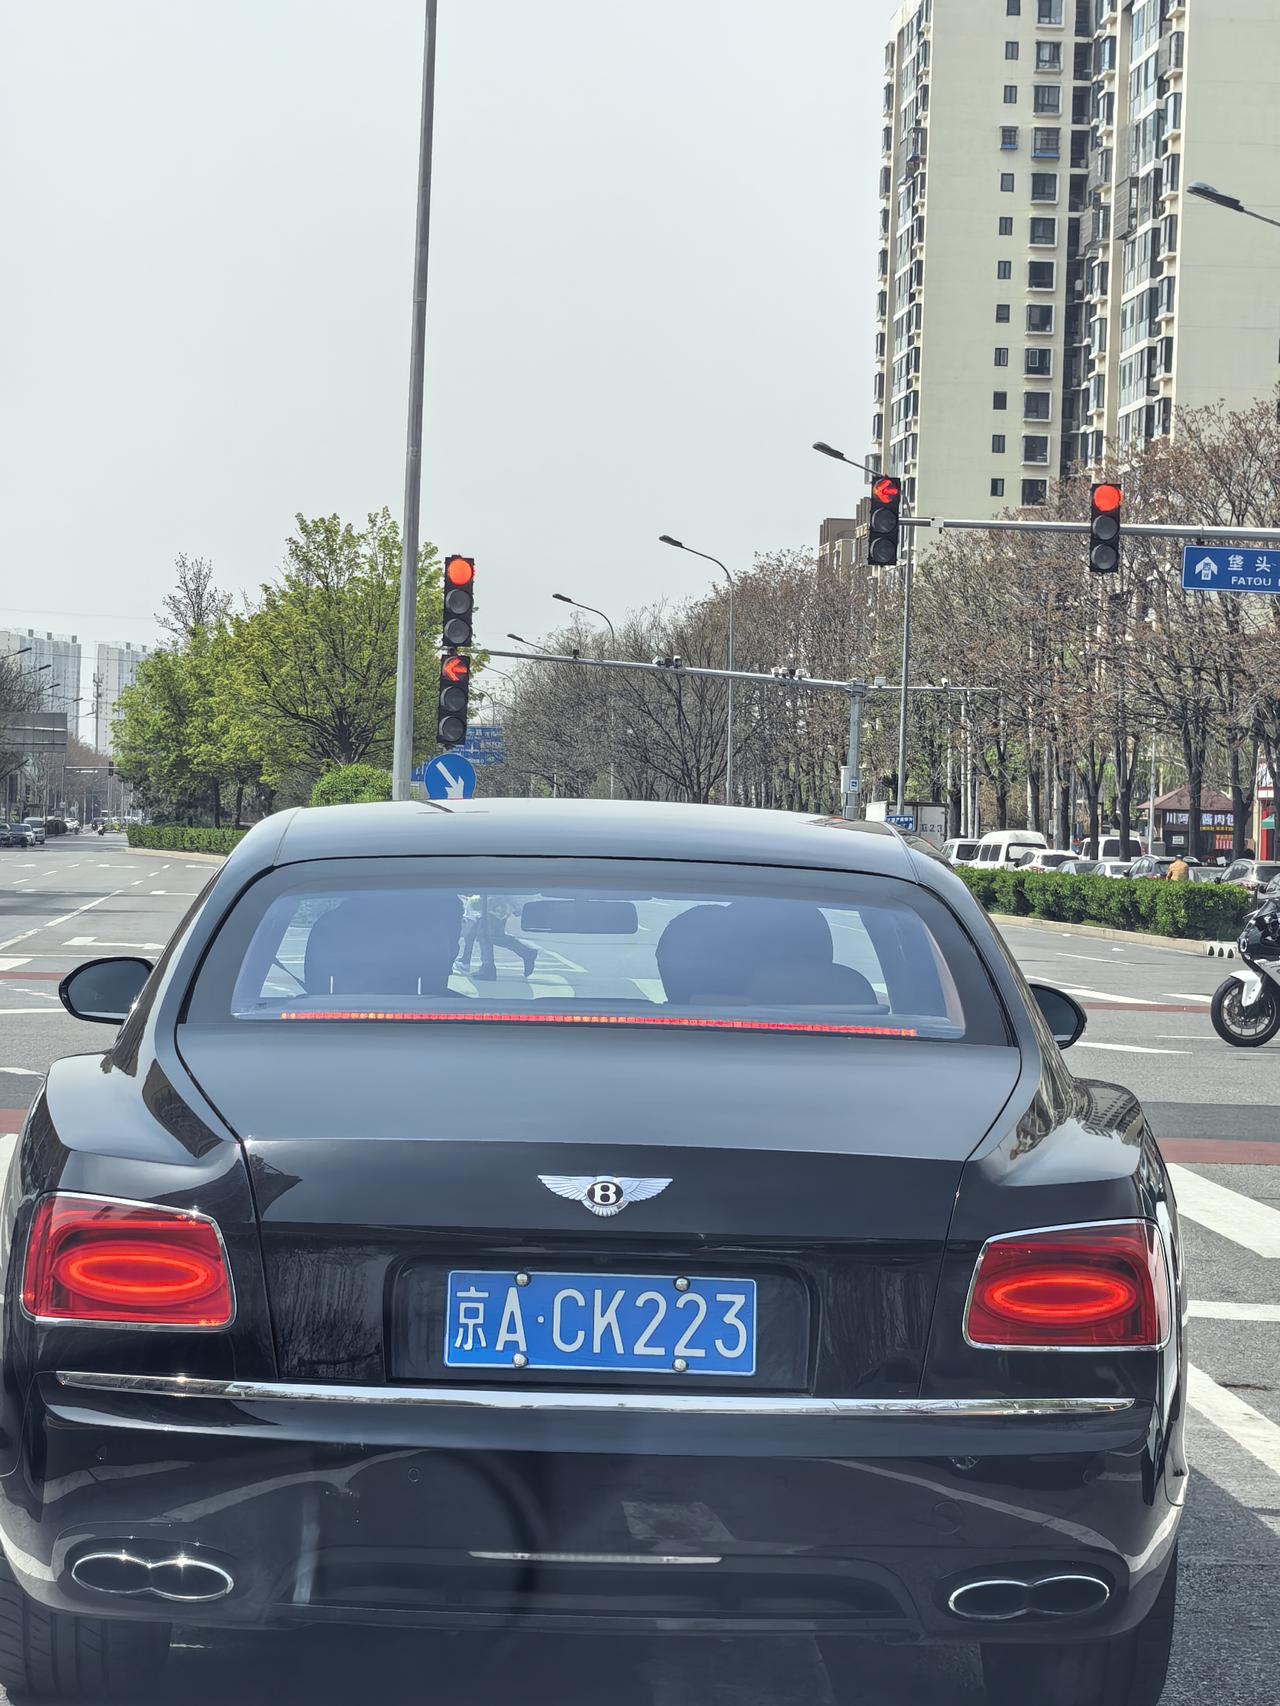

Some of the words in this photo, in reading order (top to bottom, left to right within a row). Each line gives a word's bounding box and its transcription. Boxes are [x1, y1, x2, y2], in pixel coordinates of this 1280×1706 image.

[1227, 554, 1271, 573] 垡头
[1231, 576, 1272, 586] FATOU
[593, 1181, 617, 1205] B
[454, 1286, 748, 1359] 京A·CK223
